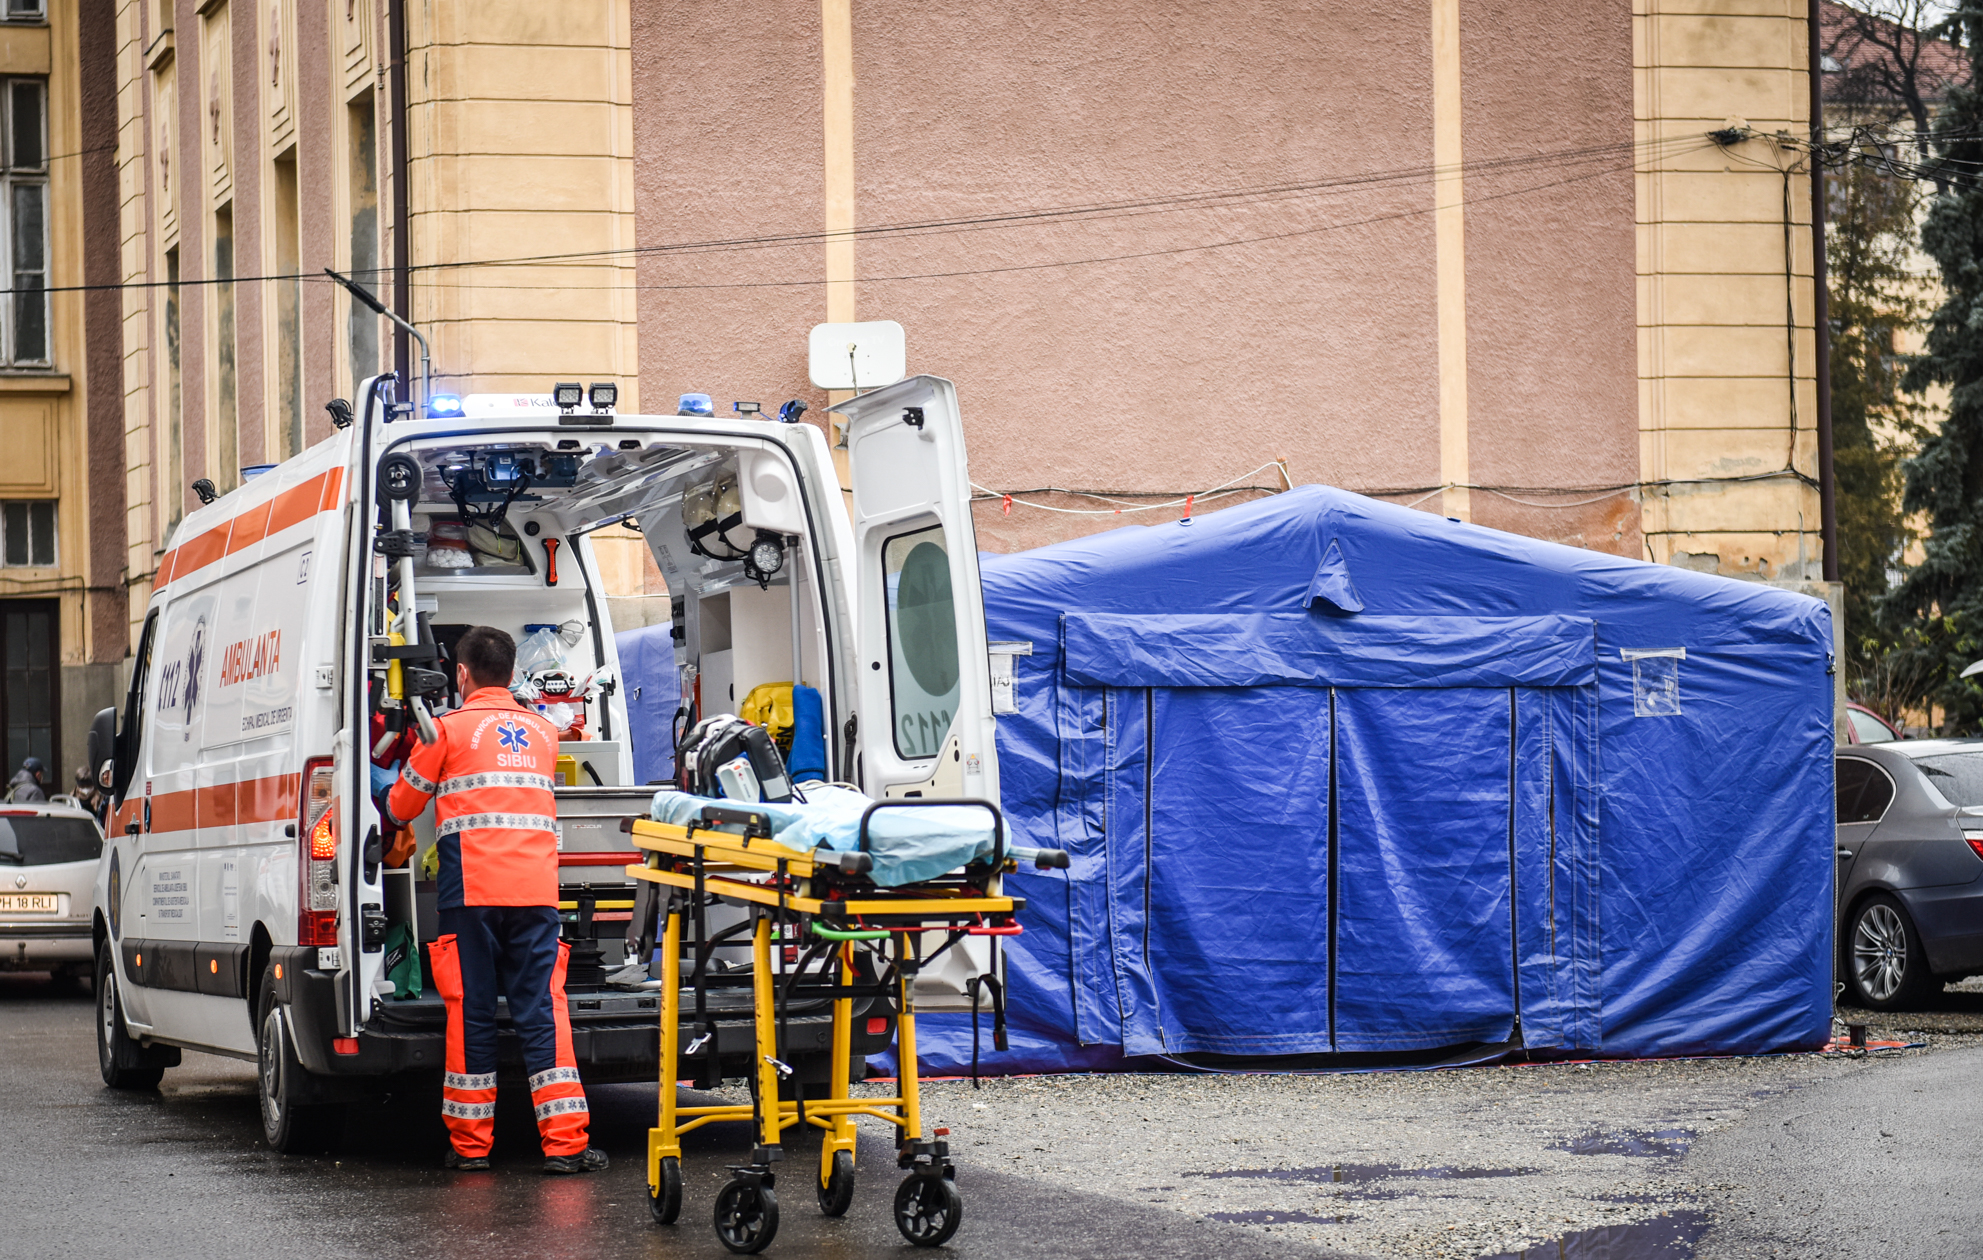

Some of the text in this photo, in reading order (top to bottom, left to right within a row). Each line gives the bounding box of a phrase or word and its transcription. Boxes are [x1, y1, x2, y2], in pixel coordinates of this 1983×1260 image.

[219, 628, 281, 688] AMBULANTA
[470, 712, 553, 755] SERVICIUL DE AMBULANTA
[497, 753, 536, 769] SIBIU
[0, 897, 51, 908] H 18 RLI
